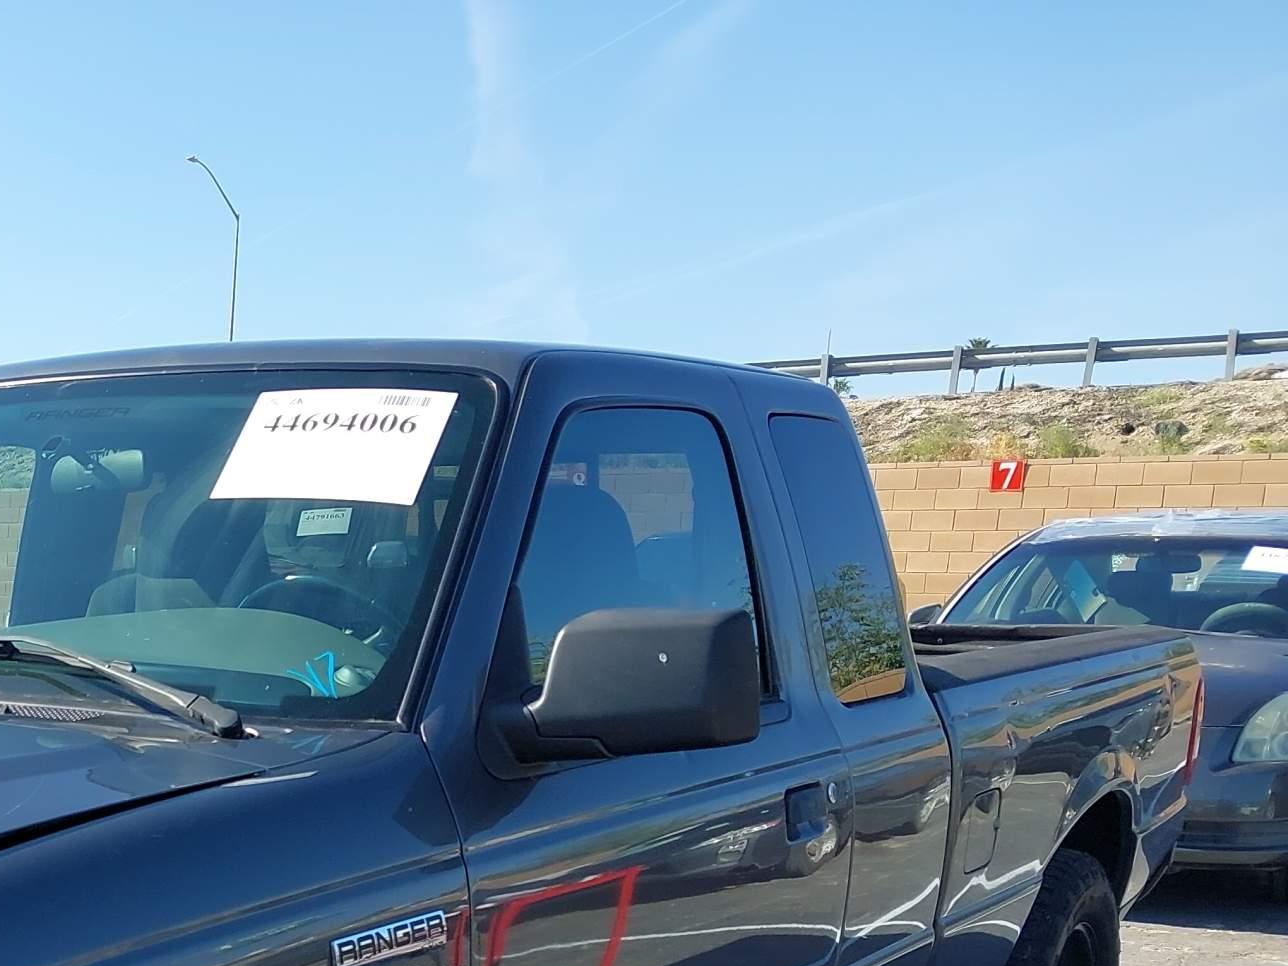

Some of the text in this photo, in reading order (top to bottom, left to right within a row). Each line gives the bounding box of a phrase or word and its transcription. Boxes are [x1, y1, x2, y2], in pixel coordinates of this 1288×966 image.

[263, 412, 420, 434] 44694006
[998, 461, 1018, 490] 7
[336, 913, 445, 966] RANGER
